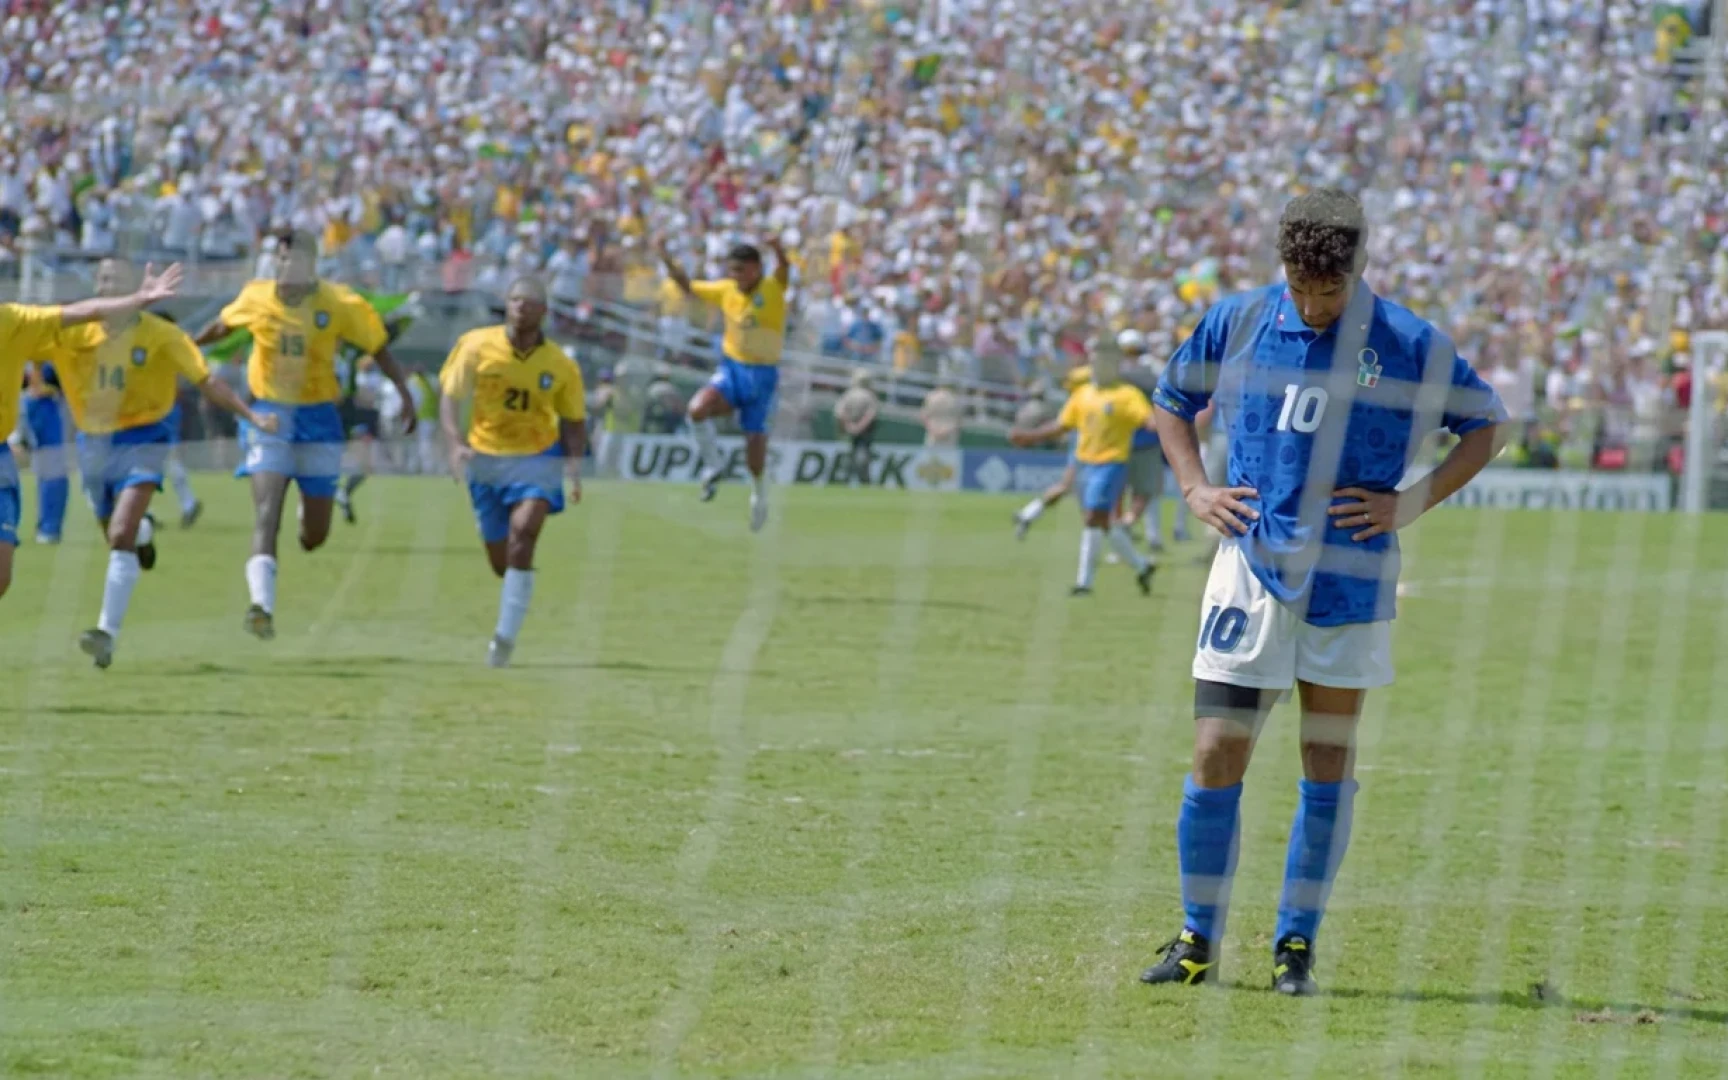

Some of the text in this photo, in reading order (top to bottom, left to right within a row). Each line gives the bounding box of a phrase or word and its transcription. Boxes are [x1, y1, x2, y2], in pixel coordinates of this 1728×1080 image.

[280, 334, 305, 356] 15
[98, 364, 125, 391] 14
[504, 388, 531, 411] 21
[1277, 384, 1329, 433] 10
[1199, 605, 1249, 652] 10
